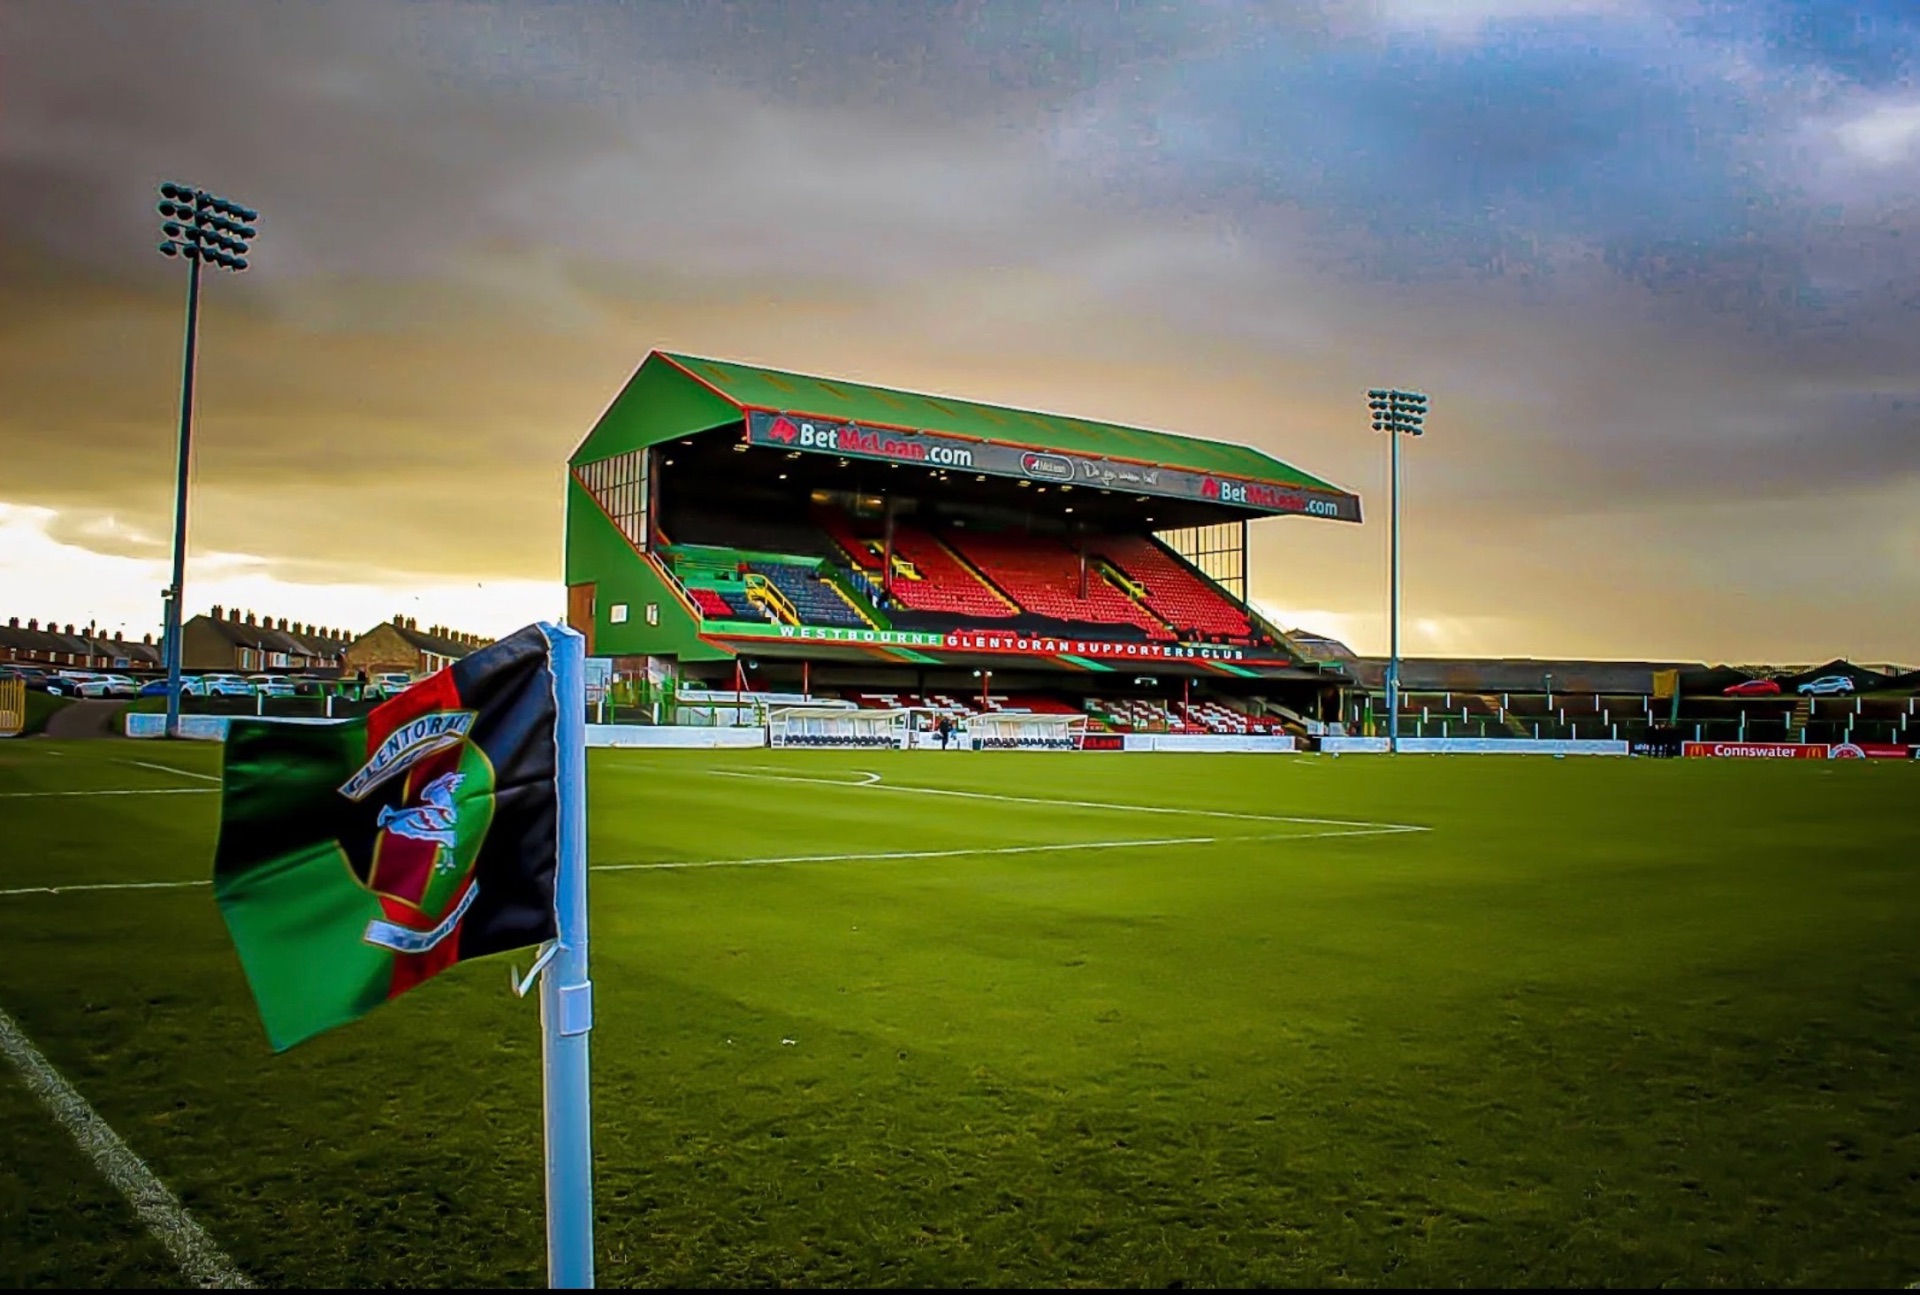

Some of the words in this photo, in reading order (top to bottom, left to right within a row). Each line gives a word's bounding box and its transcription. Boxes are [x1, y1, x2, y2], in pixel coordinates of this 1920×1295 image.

[780, 627, 939, 646] WESTBOURNE
[947, 635, 1069, 652] GLENTORAN
[1077, 643, 1195, 658] SUPPORTERS
[1201, 649, 1244, 660] CLUB
[1714, 744, 1797, 758] Connswater
